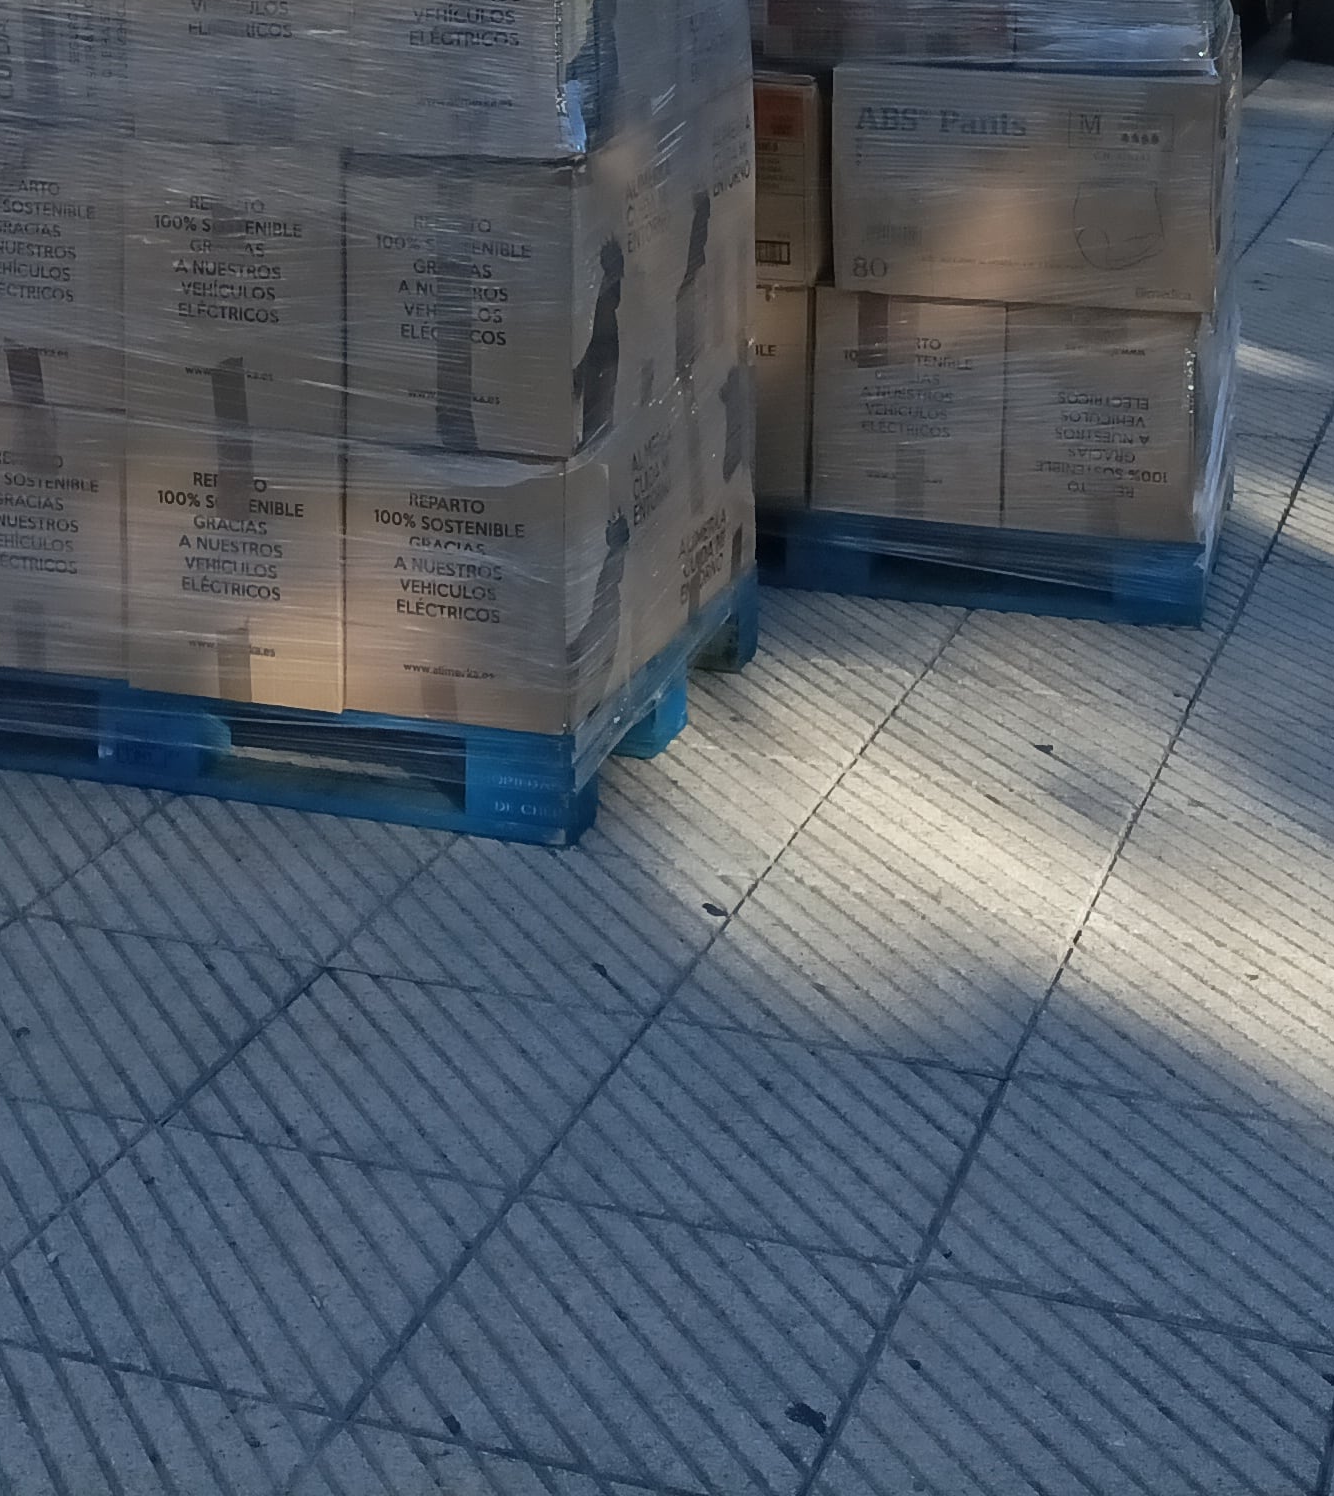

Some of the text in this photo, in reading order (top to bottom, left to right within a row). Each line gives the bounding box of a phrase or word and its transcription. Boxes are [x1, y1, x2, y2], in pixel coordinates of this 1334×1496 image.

[1081, 114, 1100, 135] M
[3, 198, 96, 220] SOSTENIBLE
[155, 215, 303, 239] 100% SENIBLE
[189, 240, 265, 258] GRAS
[175, 259, 282, 280] A NUESTROS
[413, 259, 492, 279] GRAS
[853, 256, 887, 278] 80
[181, 279, 276, 301] VEHÍCULOS
[398, 280, 409, 294] A
[4, 473, 100, 493] SOSTENIBLE
[157, 490, 304, 518] 100% SENIBLE
[409, 491, 485, 515] REPARTO
[193, 515, 268, 536] GRACIAS
[374, 508, 525, 539] 100% SOSTENIBLE
[179, 535, 283, 559] A NUESTROS
[394, 556, 503, 581] A NUESTROS
[181, 575, 281, 602] ELÉCTRICOS
[396, 597, 500, 624] ELÉCTRICOS
